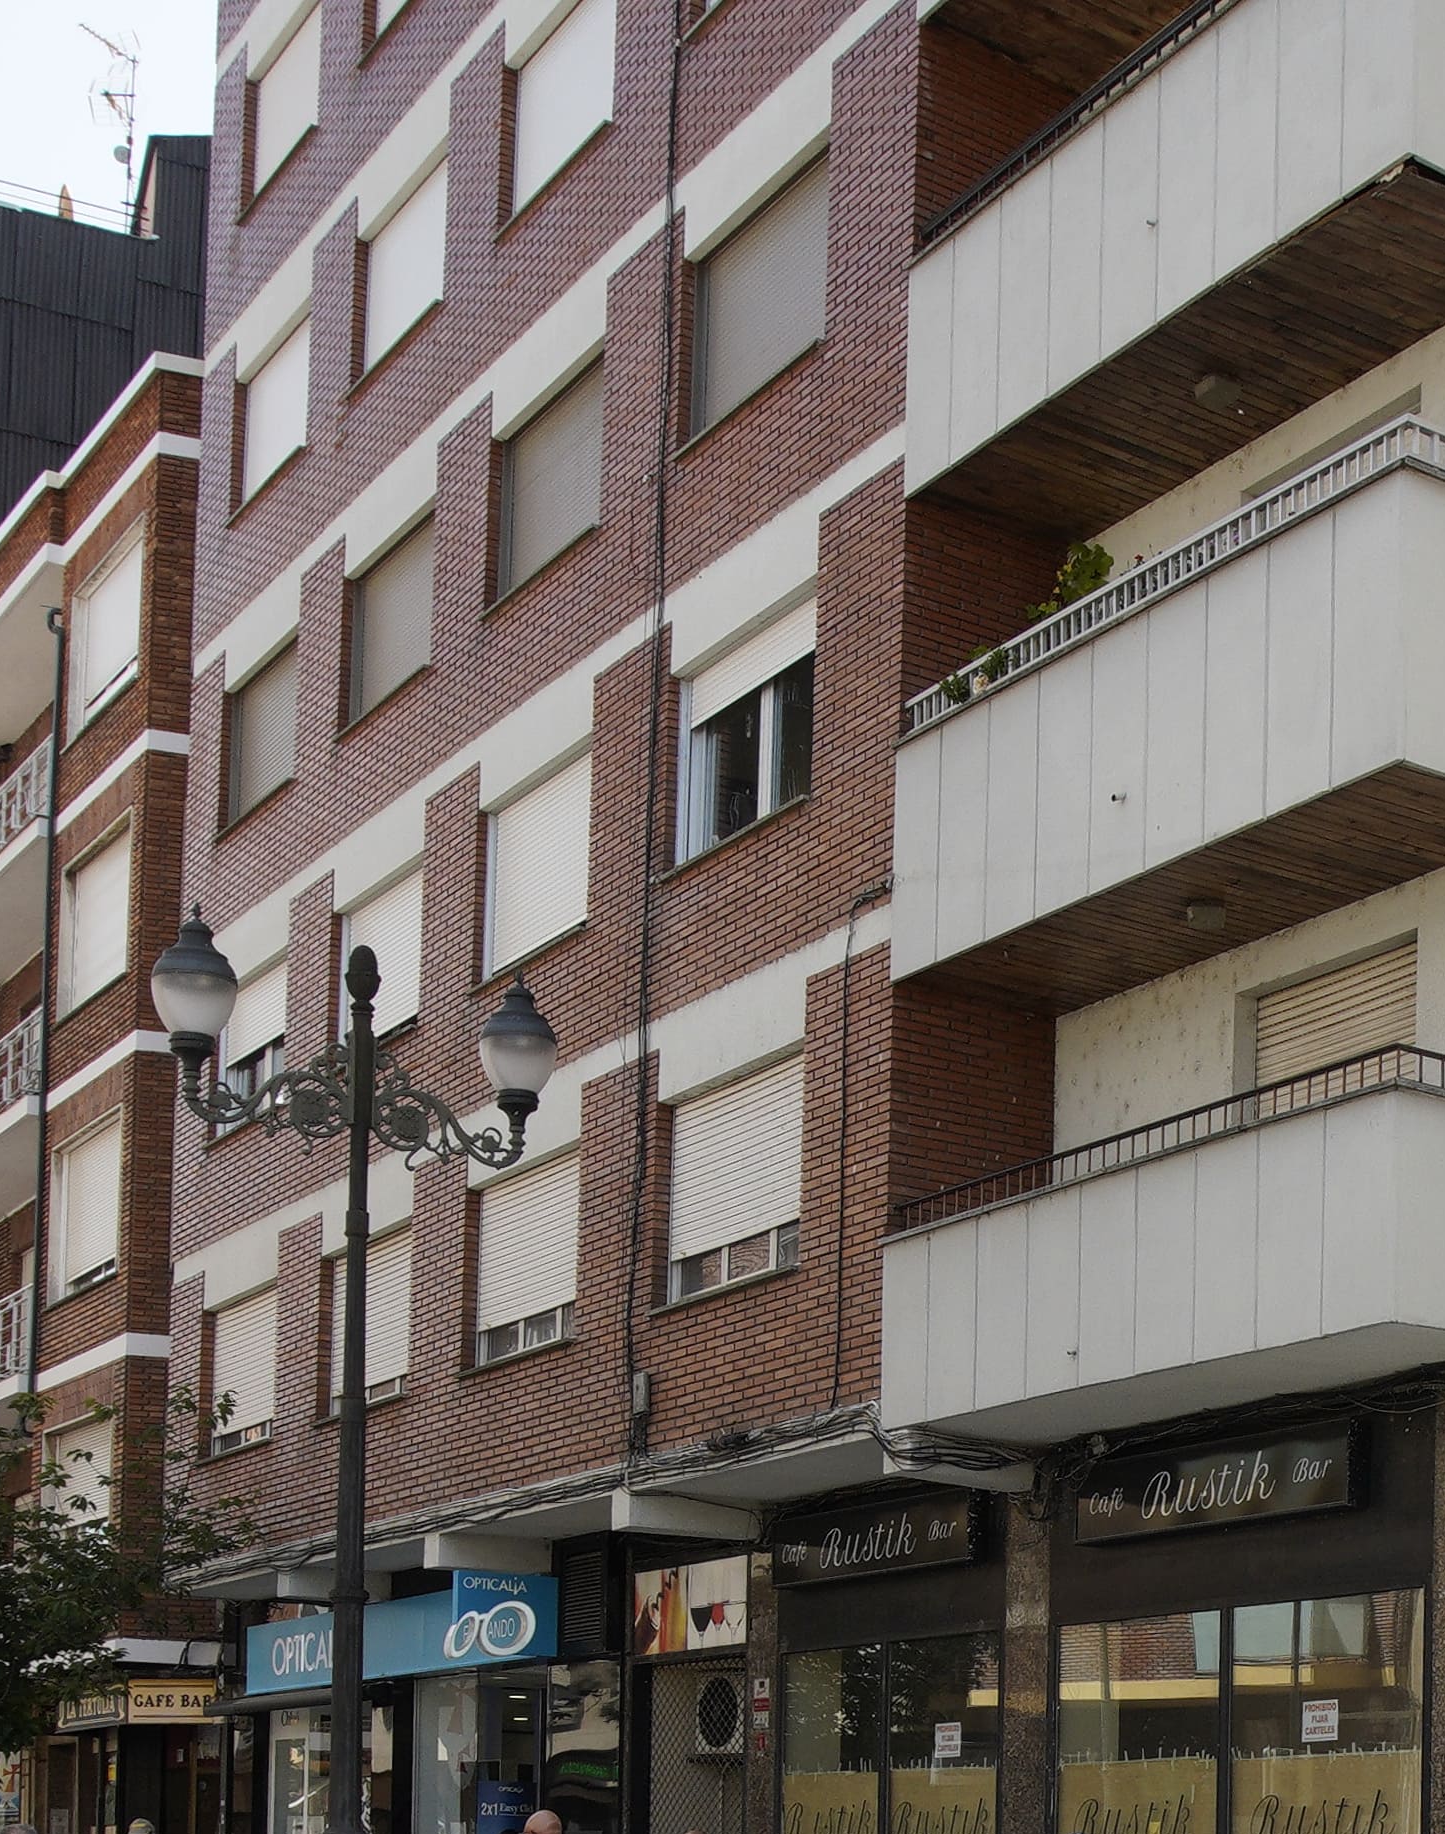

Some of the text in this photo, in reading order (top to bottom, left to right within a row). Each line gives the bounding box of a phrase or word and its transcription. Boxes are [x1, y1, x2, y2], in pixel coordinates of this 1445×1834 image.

[1090, 1450, 1333, 1520] Café Rustik Bar
[782, 1512, 958, 1569] Café Rustik Bar
[462, 1576, 527, 1596] OPTICALIA
[271, 1628, 333, 1676] OPTICAL
[1304, 1702, 1337, 1713] PROHIBIDO
[1311, 1713, 1329, 1723] FIJAR
[1305, 1725, 1335, 1736] CARTELES
